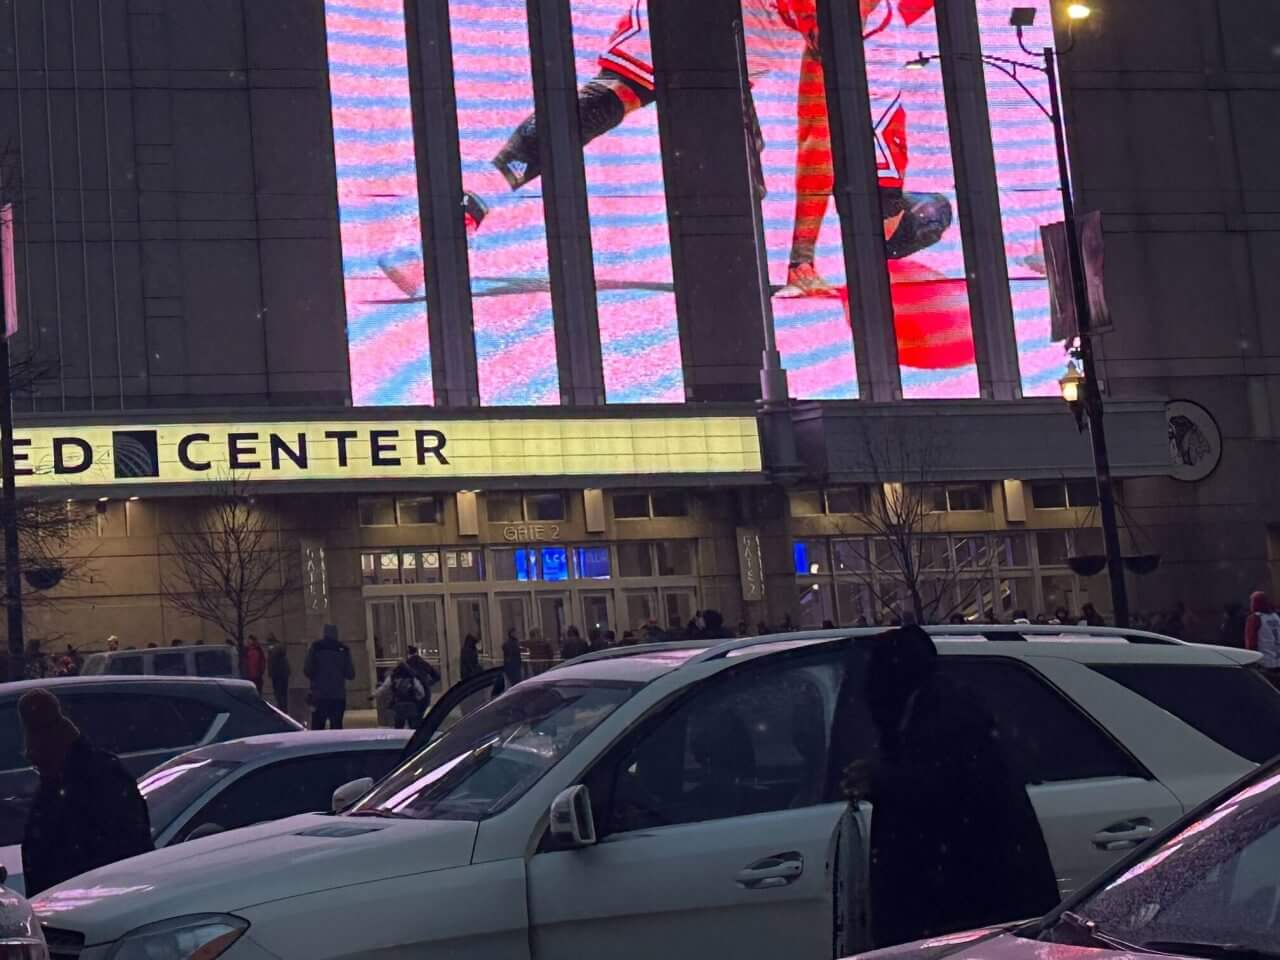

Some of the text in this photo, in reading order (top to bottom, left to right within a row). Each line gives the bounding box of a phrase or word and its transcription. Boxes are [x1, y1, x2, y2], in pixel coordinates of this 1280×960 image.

[176, 429, 450, 472] CENTER
[504, 524, 561, 541] GATE 2
